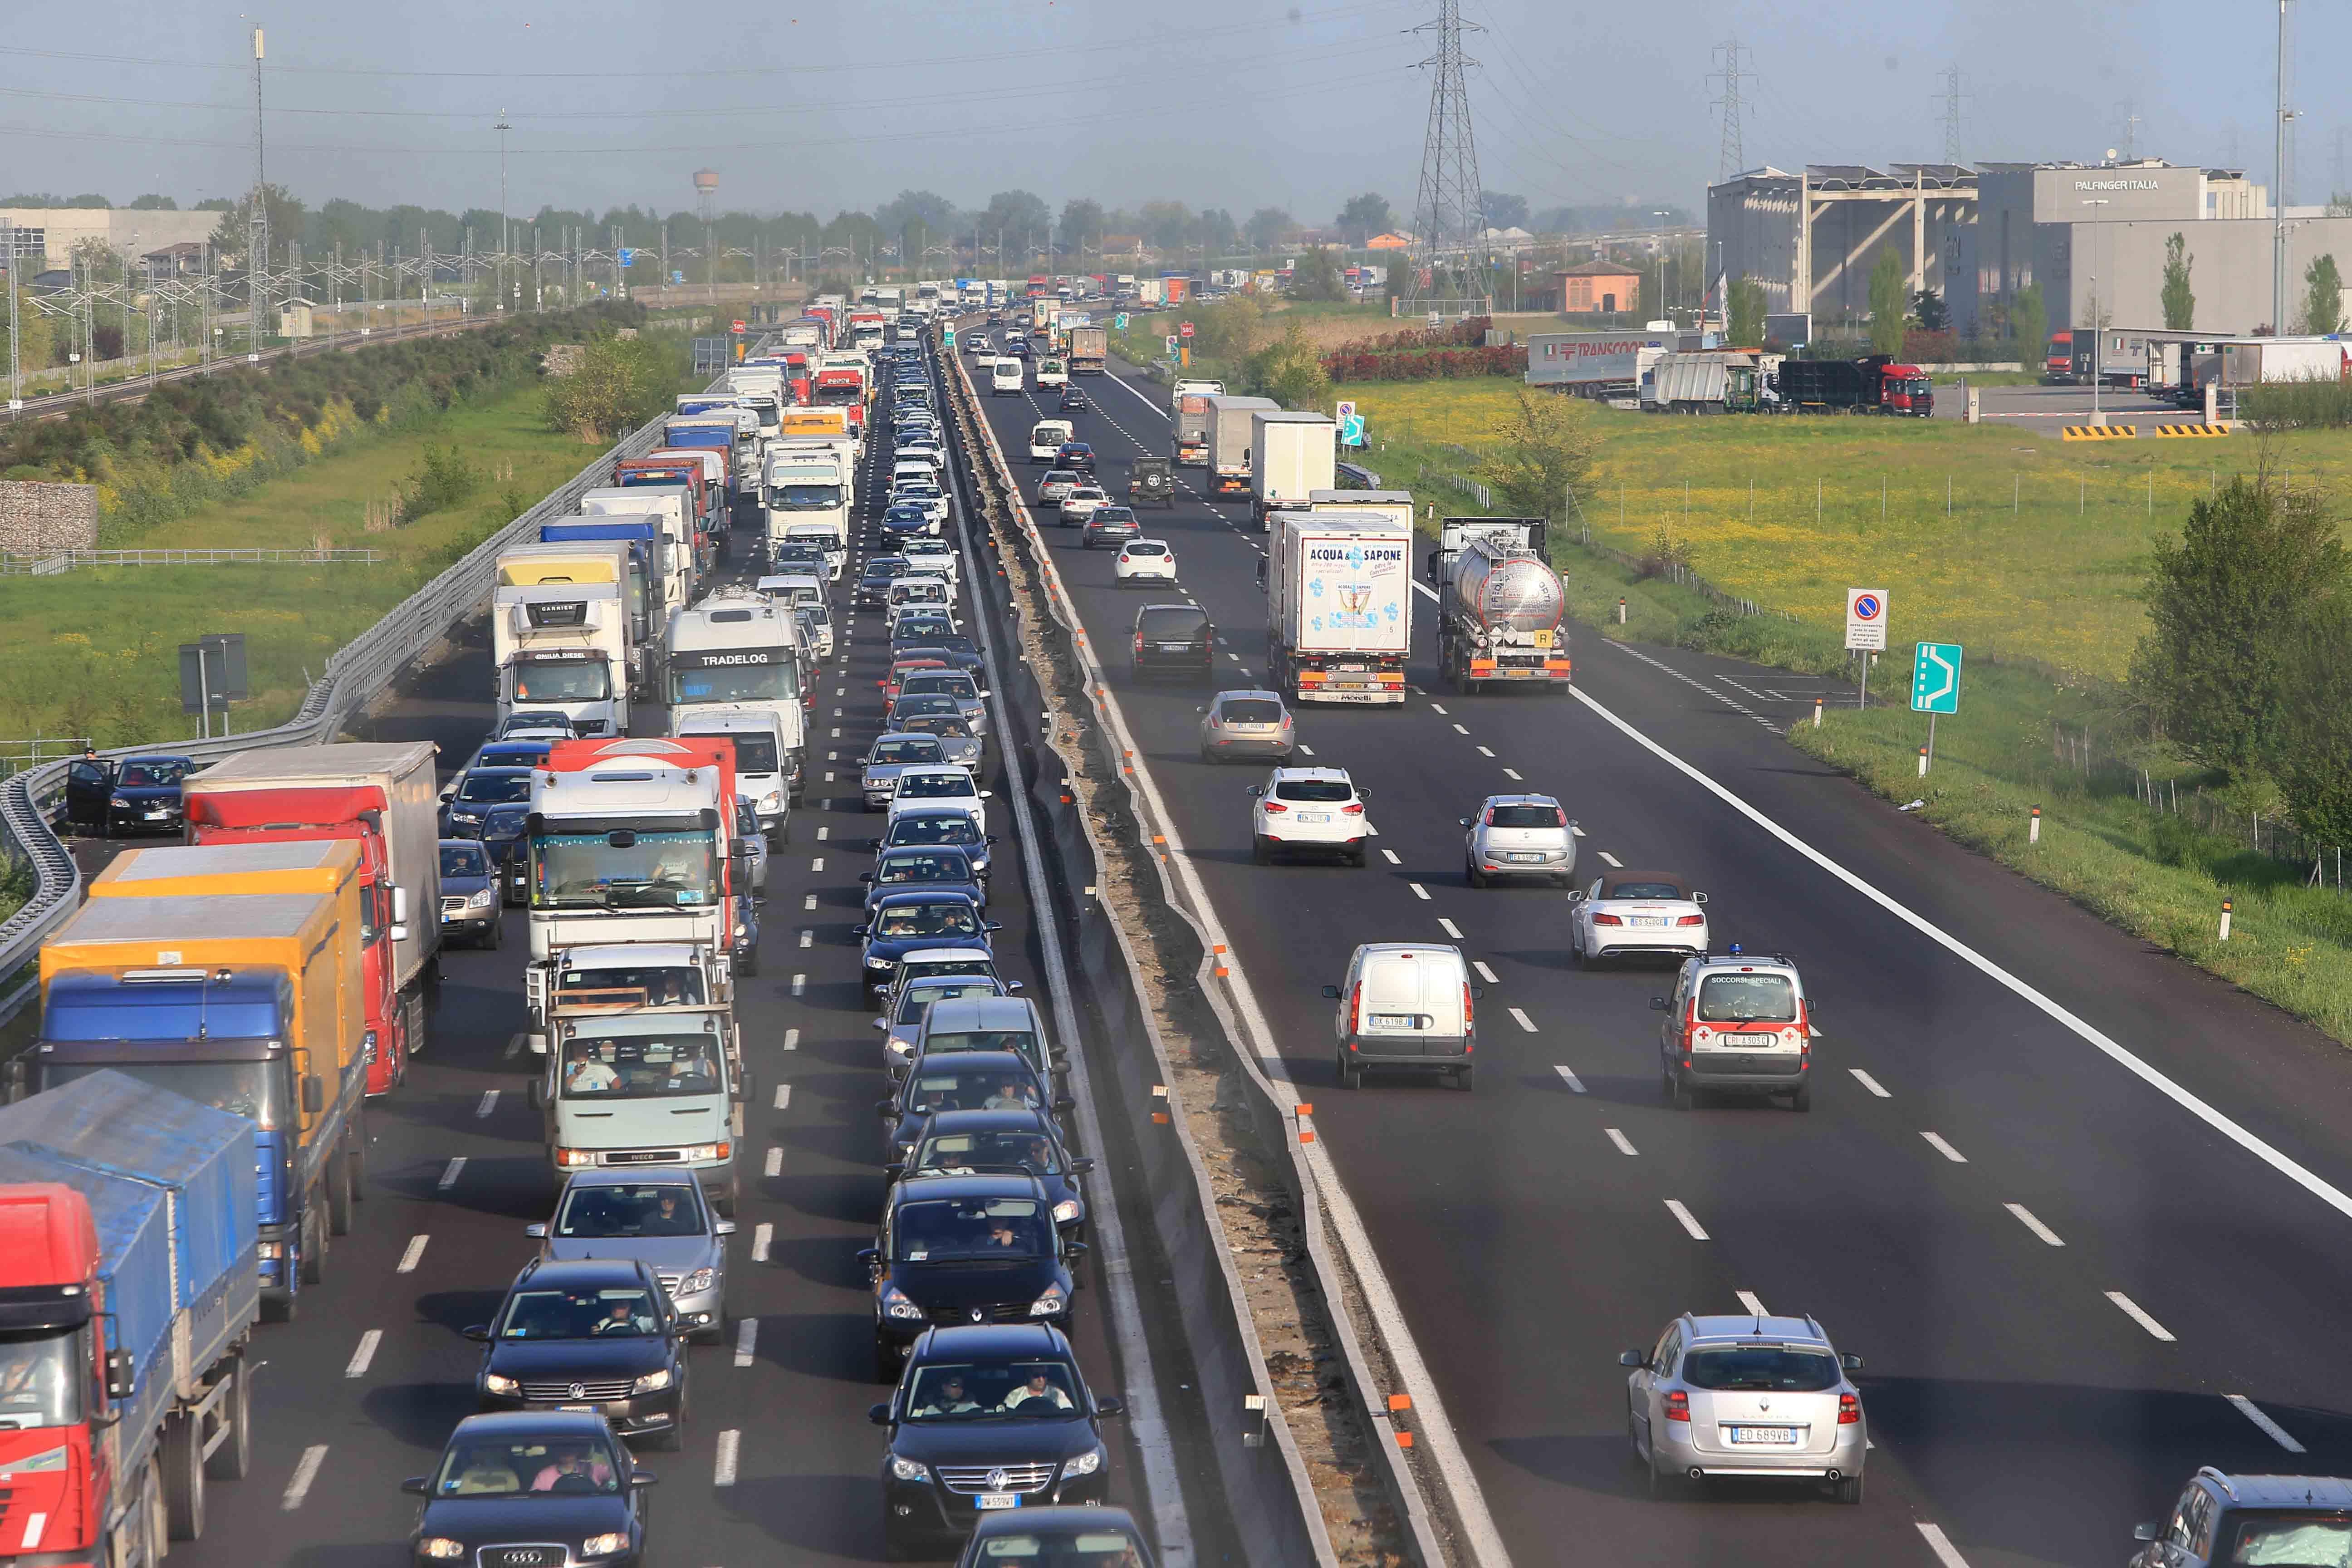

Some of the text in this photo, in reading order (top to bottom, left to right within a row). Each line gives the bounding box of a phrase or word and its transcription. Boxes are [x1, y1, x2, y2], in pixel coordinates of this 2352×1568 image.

[2075, 180, 2159, 190] PALFINGER ITALIA
[1310, 549, 1343, 561] ACQUA
[1364, 550, 1401, 561] SAPONE
[1539, 634, 1547, 643] R
[701, 653, 768, 666] TRADELOG
[1740, 1429, 1789, 1441] ED 689VB
